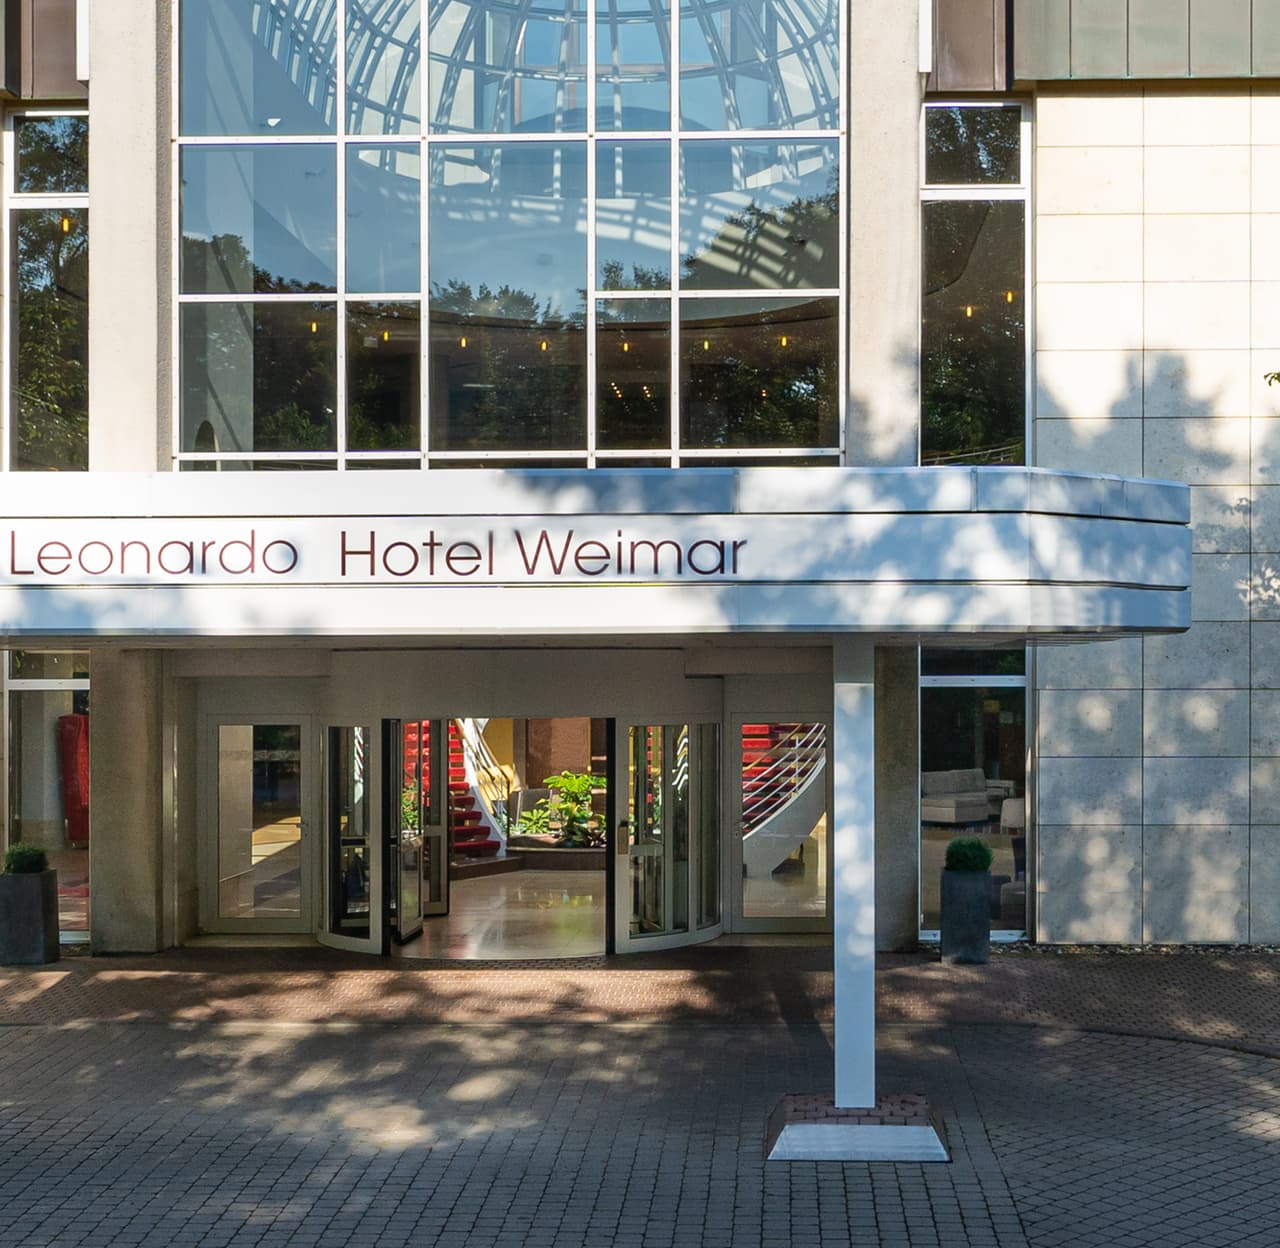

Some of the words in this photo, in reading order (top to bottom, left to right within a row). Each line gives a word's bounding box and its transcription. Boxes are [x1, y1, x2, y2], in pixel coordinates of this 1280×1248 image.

[10, 530, 299, 577] Leonardo
[340, 531, 495, 577] Hotel
[514, 530, 748, 576] Weimar
